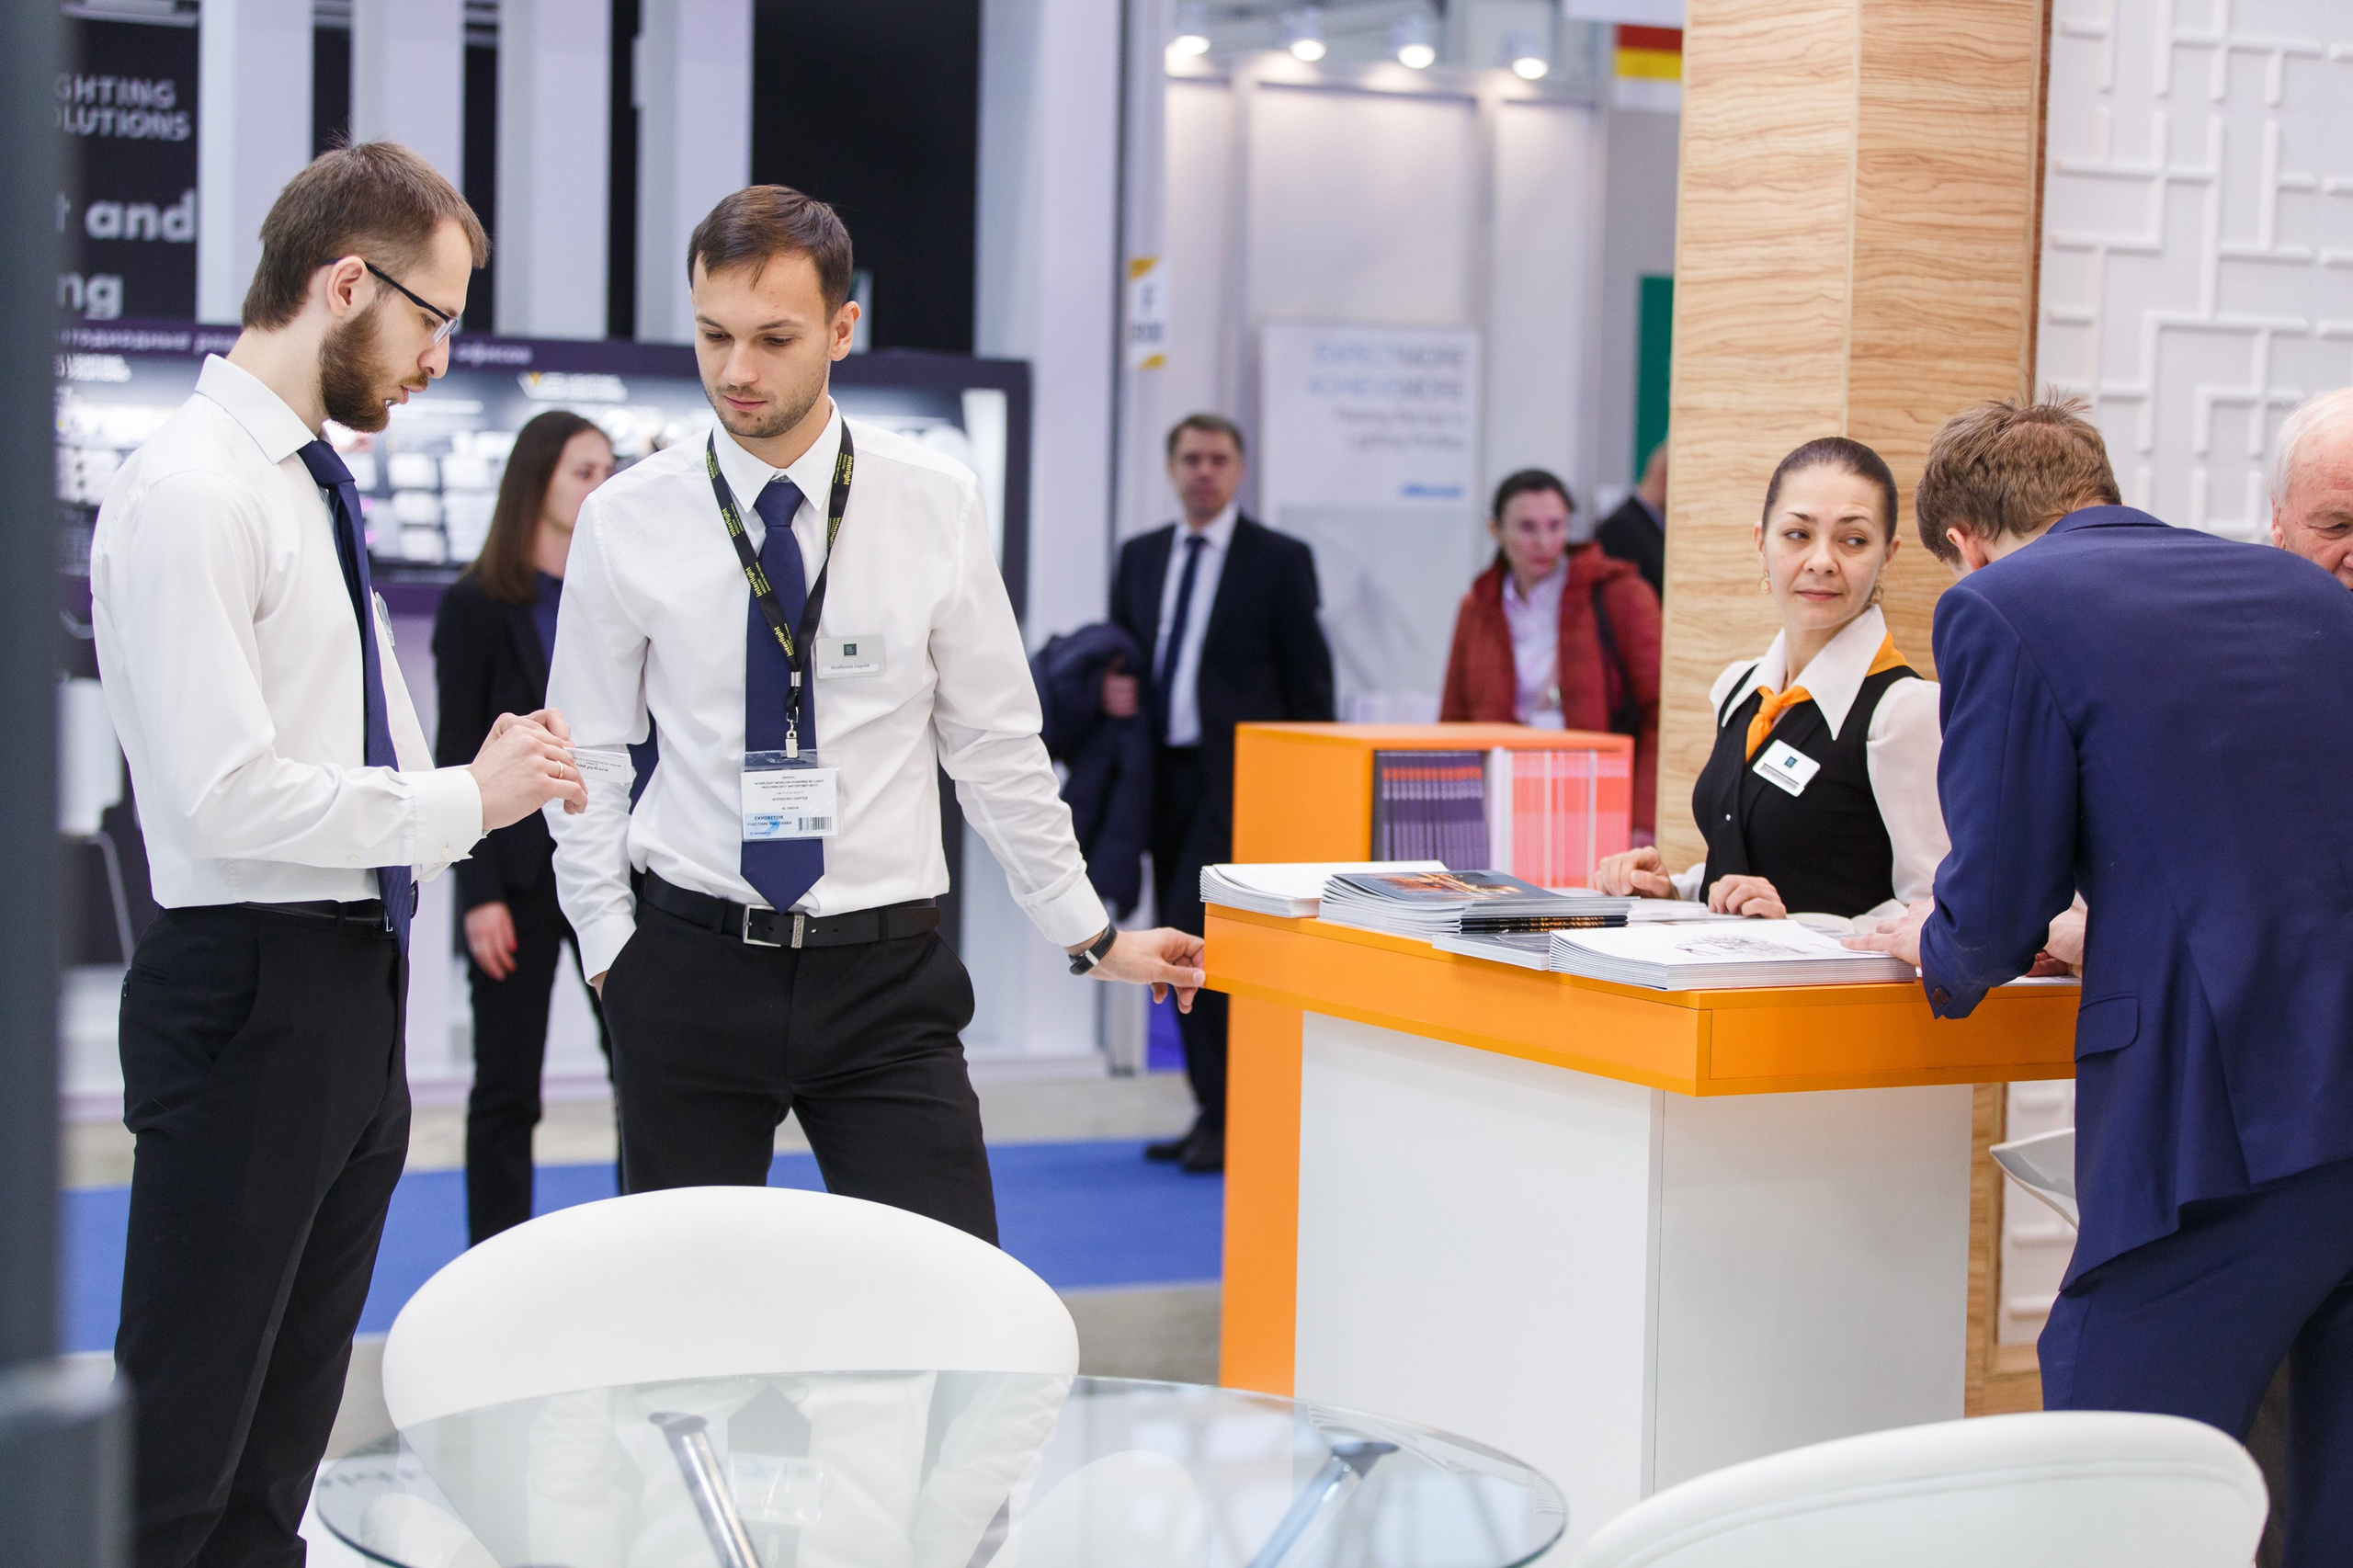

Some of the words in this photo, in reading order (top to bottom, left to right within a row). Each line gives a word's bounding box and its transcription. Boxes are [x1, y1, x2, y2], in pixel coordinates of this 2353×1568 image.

[85, 187, 197, 243] and
[843, 455, 854, 485] interlight
[722, 507, 737, 538] interlight
[745, 566, 763, 598] interlight
[773, 626, 793, 657] interlight
